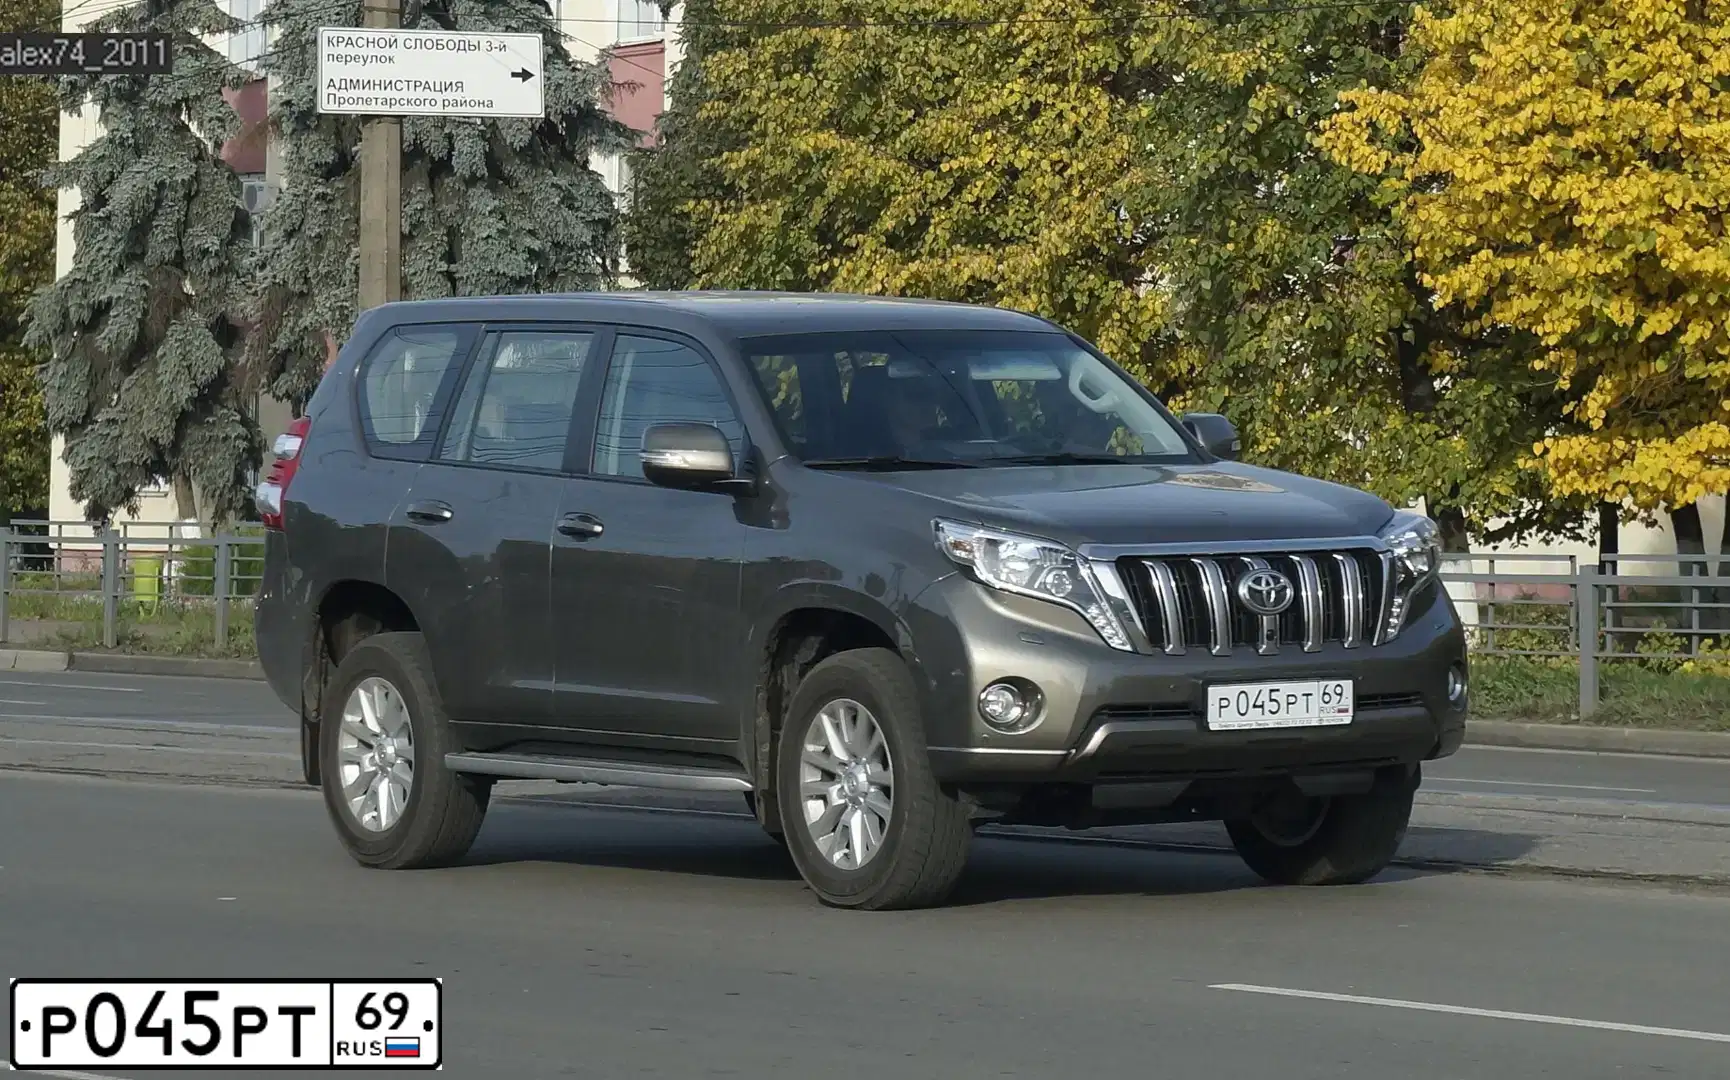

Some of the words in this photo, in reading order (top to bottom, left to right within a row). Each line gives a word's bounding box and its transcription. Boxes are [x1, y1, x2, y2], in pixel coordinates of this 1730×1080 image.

[327, 35, 398, 50] КРАСНОЙ
[403, 36, 481, 52] СЛОБОДЫ
[485, 40, 507, 53] 3-й
[327, 52, 396, 67] переулок
[327, 78, 465, 94] АДМИНИСТРАЦИЯ
[327, 92, 438, 108] Пролетарского
[442, 96, 494, 110] района
[1321, 683, 1344, 705] 69
[1320, 706, 1337, 715] RUS
